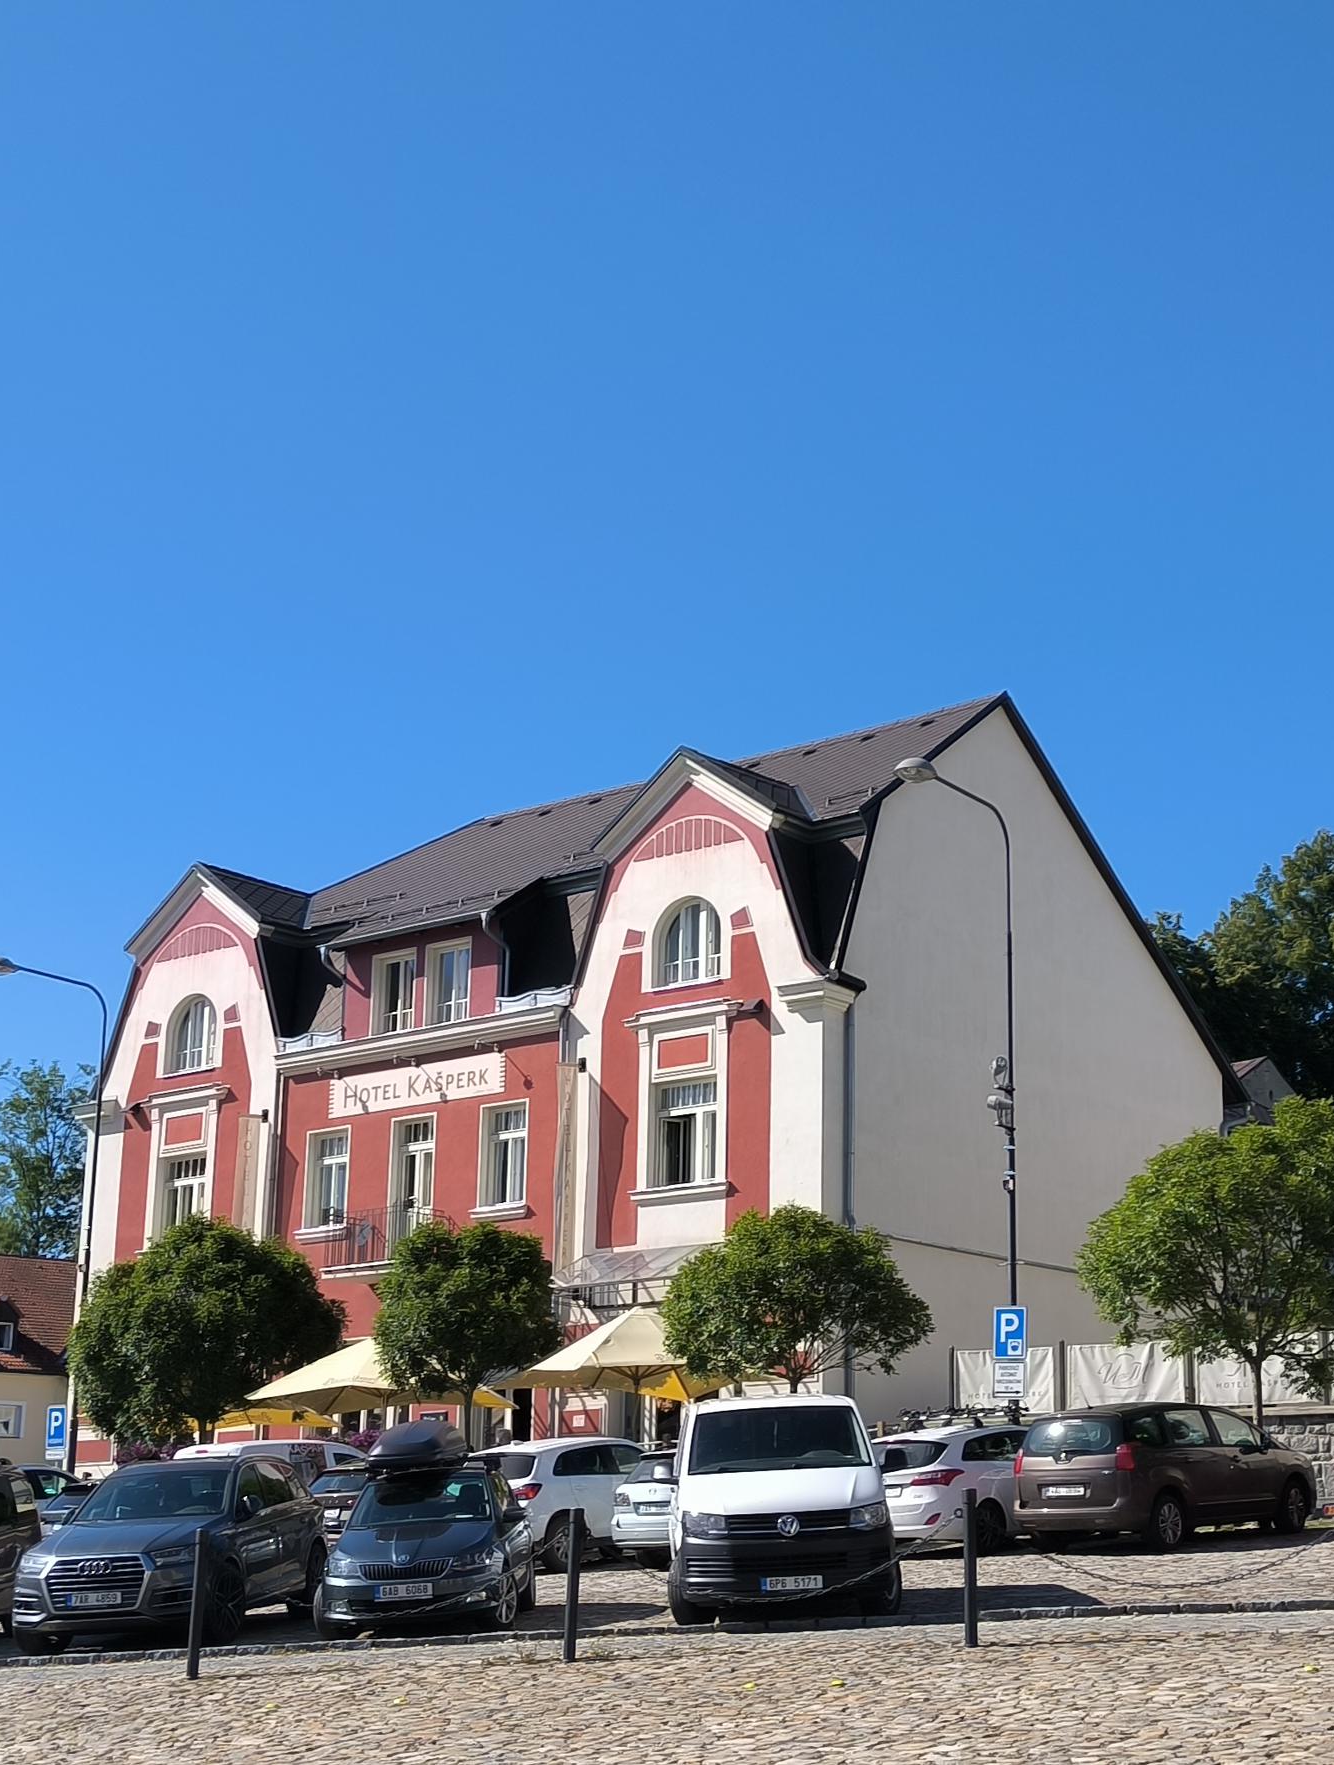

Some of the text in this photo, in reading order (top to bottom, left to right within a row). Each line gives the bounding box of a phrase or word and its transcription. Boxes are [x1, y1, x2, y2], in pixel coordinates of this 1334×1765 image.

[343, 1068, 489, 1109] HOTEL KAŠPERK
[999, 1312, 1020, 1343] P
[967, 1392, 996, 1400] HOTE
[50, 1411, 63, 1436] P
[794, 1577, 818, 1588] 5171
